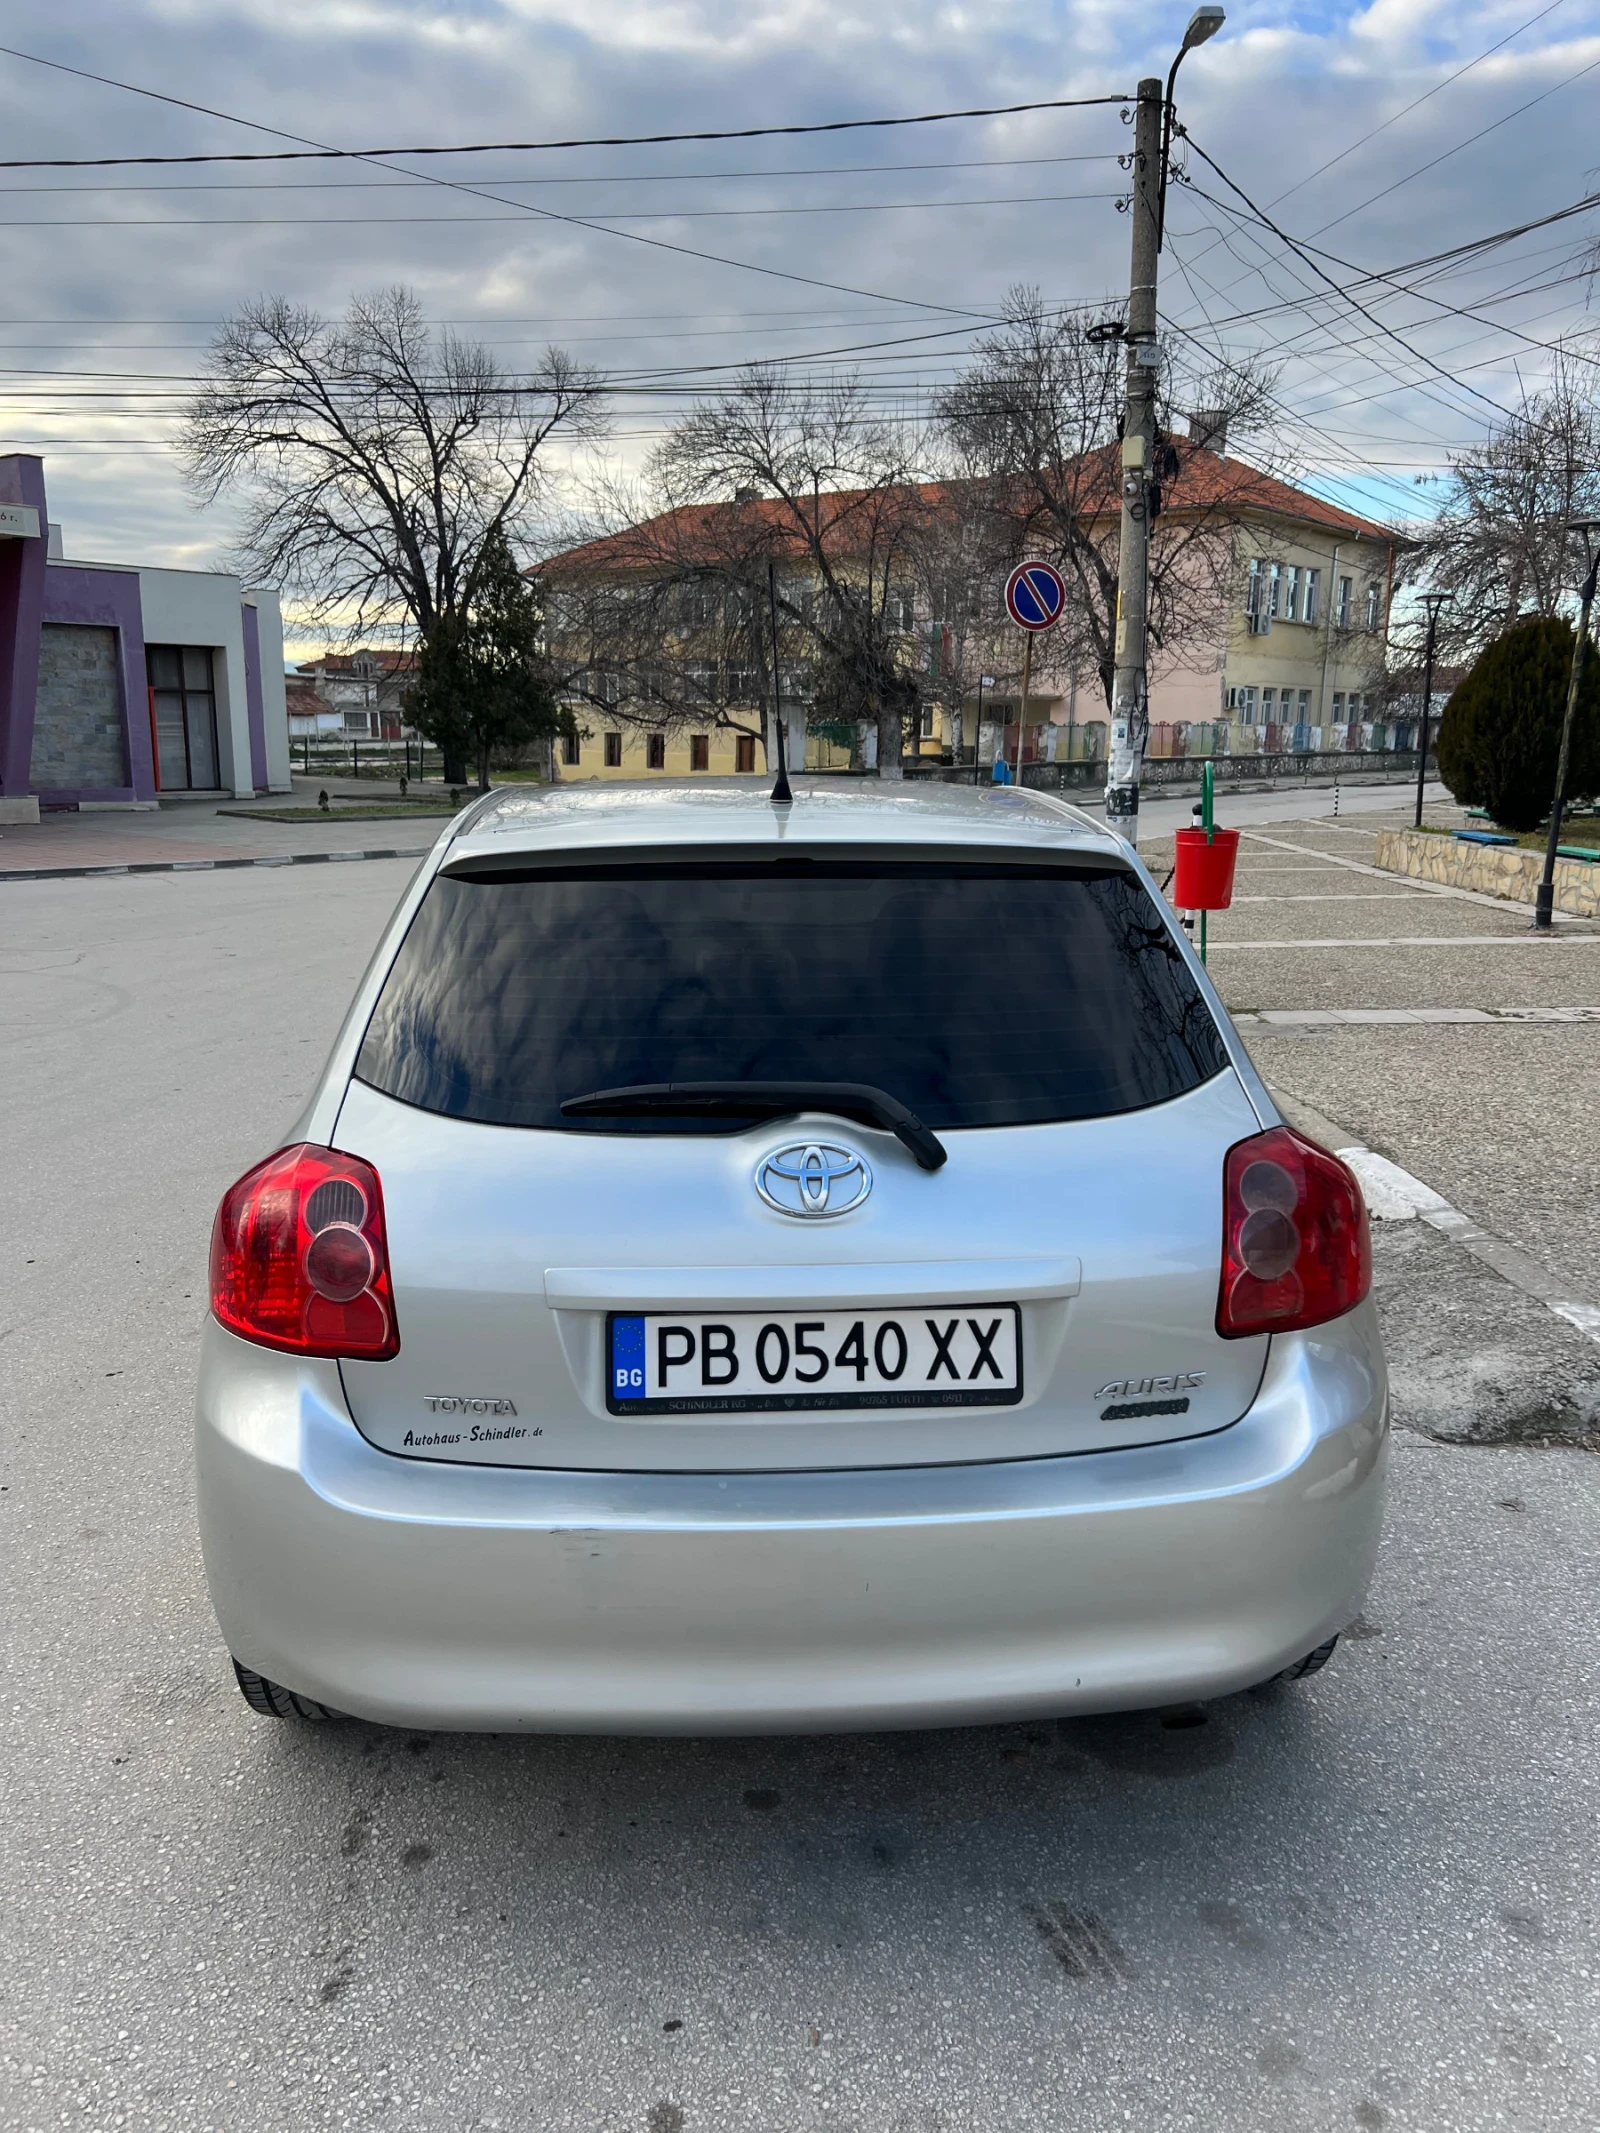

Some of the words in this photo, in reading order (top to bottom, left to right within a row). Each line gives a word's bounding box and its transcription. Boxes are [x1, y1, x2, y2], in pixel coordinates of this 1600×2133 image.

[658, 1325, 740, 1388] PB
[755, 1320, 908, 1384] 0540
[925, 1319, 1004, 1380] XX
[616, 1369, 643, 1387] BG
[1094, 1371, 1207, 1400] AURIS
[423, 1395, 518, 1417] TOYOTA
